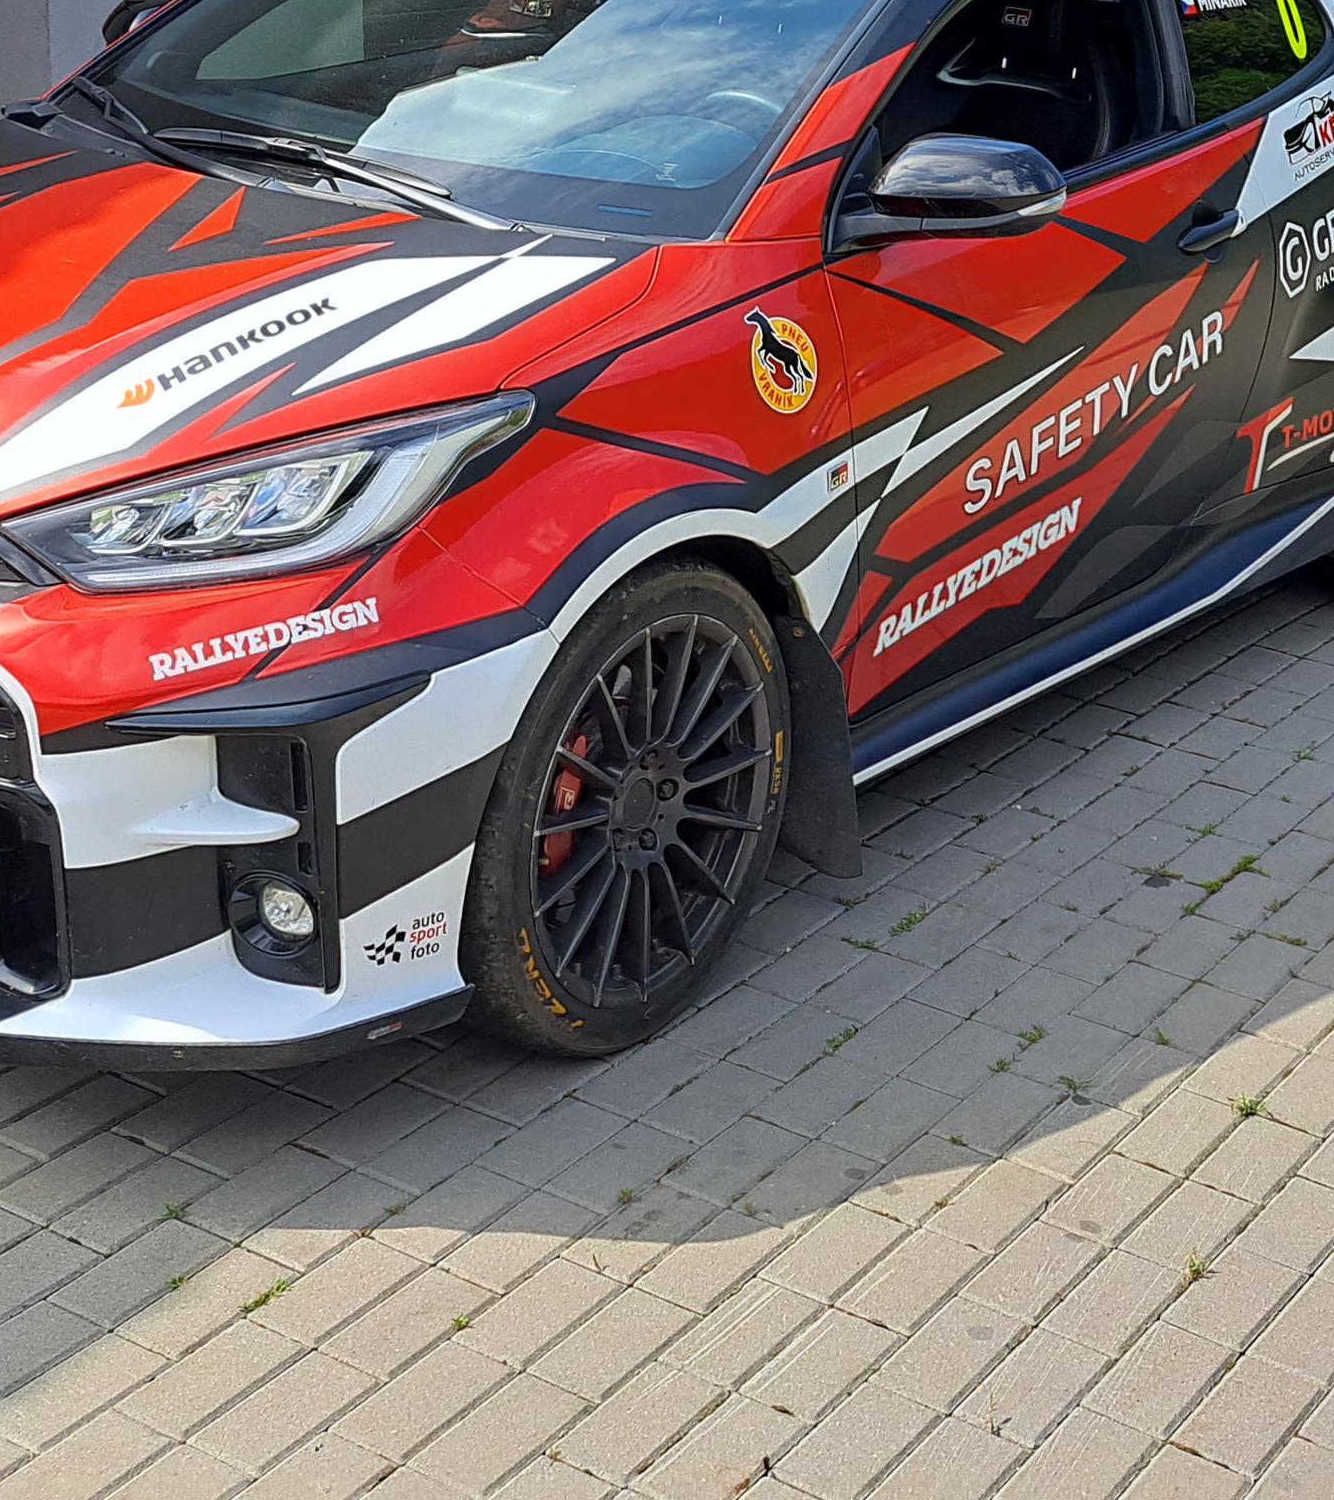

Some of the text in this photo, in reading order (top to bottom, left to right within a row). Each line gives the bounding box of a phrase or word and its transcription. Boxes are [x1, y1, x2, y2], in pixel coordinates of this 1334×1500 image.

[780, 322, 809, 353] PNEU
[962, 309, 1226, 516] SAFETY CAR
[829, 467, 848, 490] GR
[872, 496, 1083, 658] RALLYEDESIGN
[148, 597, 380, 682] RALLYEDESIGN
[409, 922, 447, 945] sport
[412, 911, 445, 930] auto
[410, 941, 440, 960] foto
